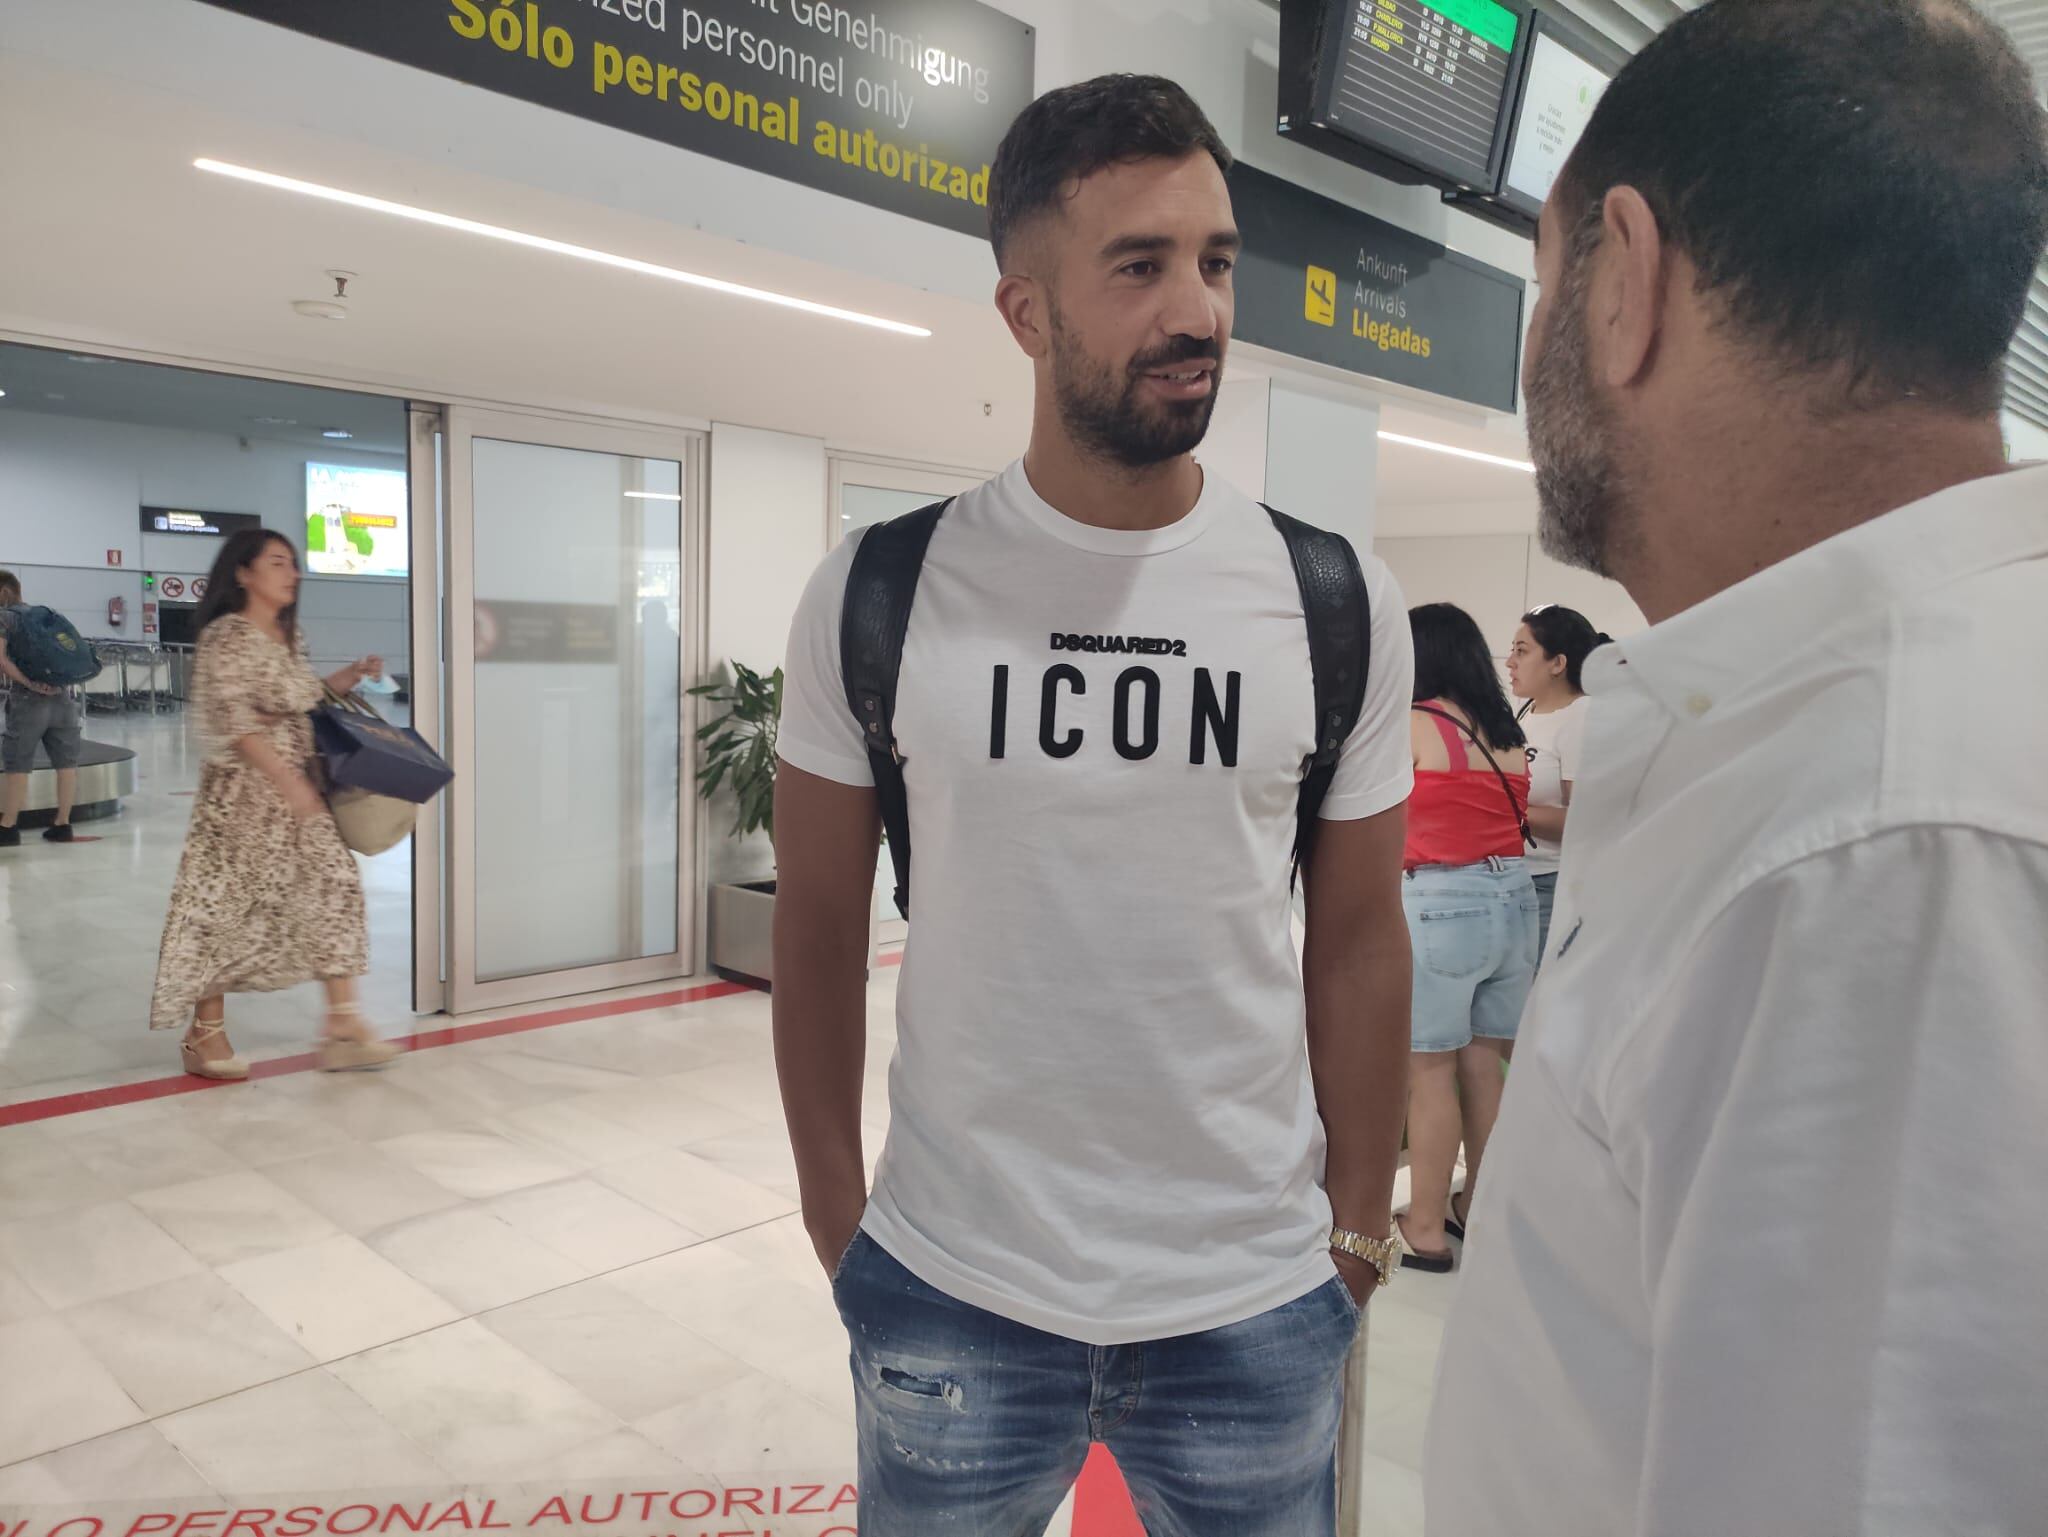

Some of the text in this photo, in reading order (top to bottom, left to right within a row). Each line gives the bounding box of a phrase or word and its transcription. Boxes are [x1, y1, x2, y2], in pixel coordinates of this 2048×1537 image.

[448, 0, 574, 69] Sólo
[593, 41, 800, 146] personal
[682, 8, 844, 97] personnel
[855, 77, 914, 129] only
[791, 0, 990, 104] Genehmigung
[1356, 247, 1408, 288] Ankunft
[1354, 280, 1407, 319] Arrivals
[1352, 308, 1431, 358] Llegadas
[1050, 633, 1187, 657] DSQUARED2
[990, 663, 1241, 767] ICON
[123, 1500, 512, 1537] PERSONAL
